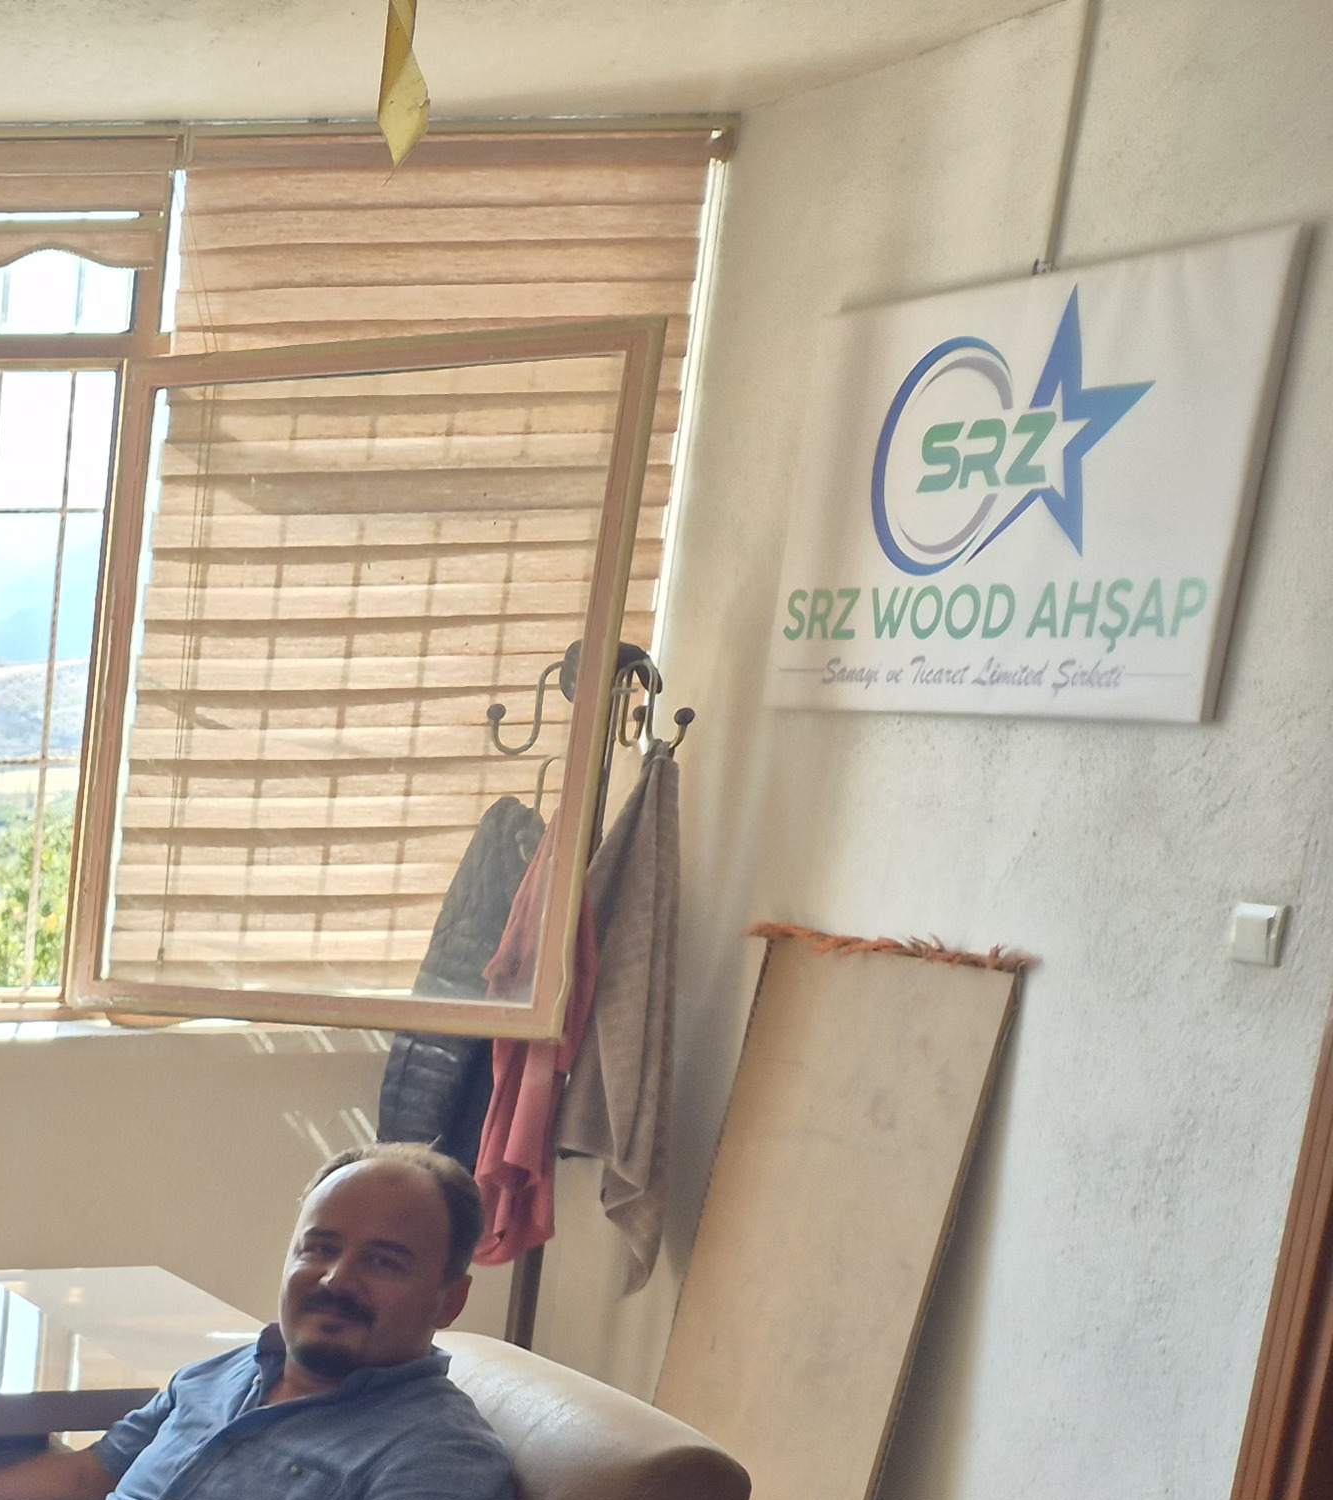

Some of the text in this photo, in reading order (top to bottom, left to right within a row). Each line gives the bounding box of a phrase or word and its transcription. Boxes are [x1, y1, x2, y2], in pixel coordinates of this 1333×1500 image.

[915, 411, 1057, 493] SRZ
[783, 577, 1209, 654] SRZ WOOD AHŞAP
[821, 655, 1126, 697] Sanayi ve Ticaret Limited Şirketi
